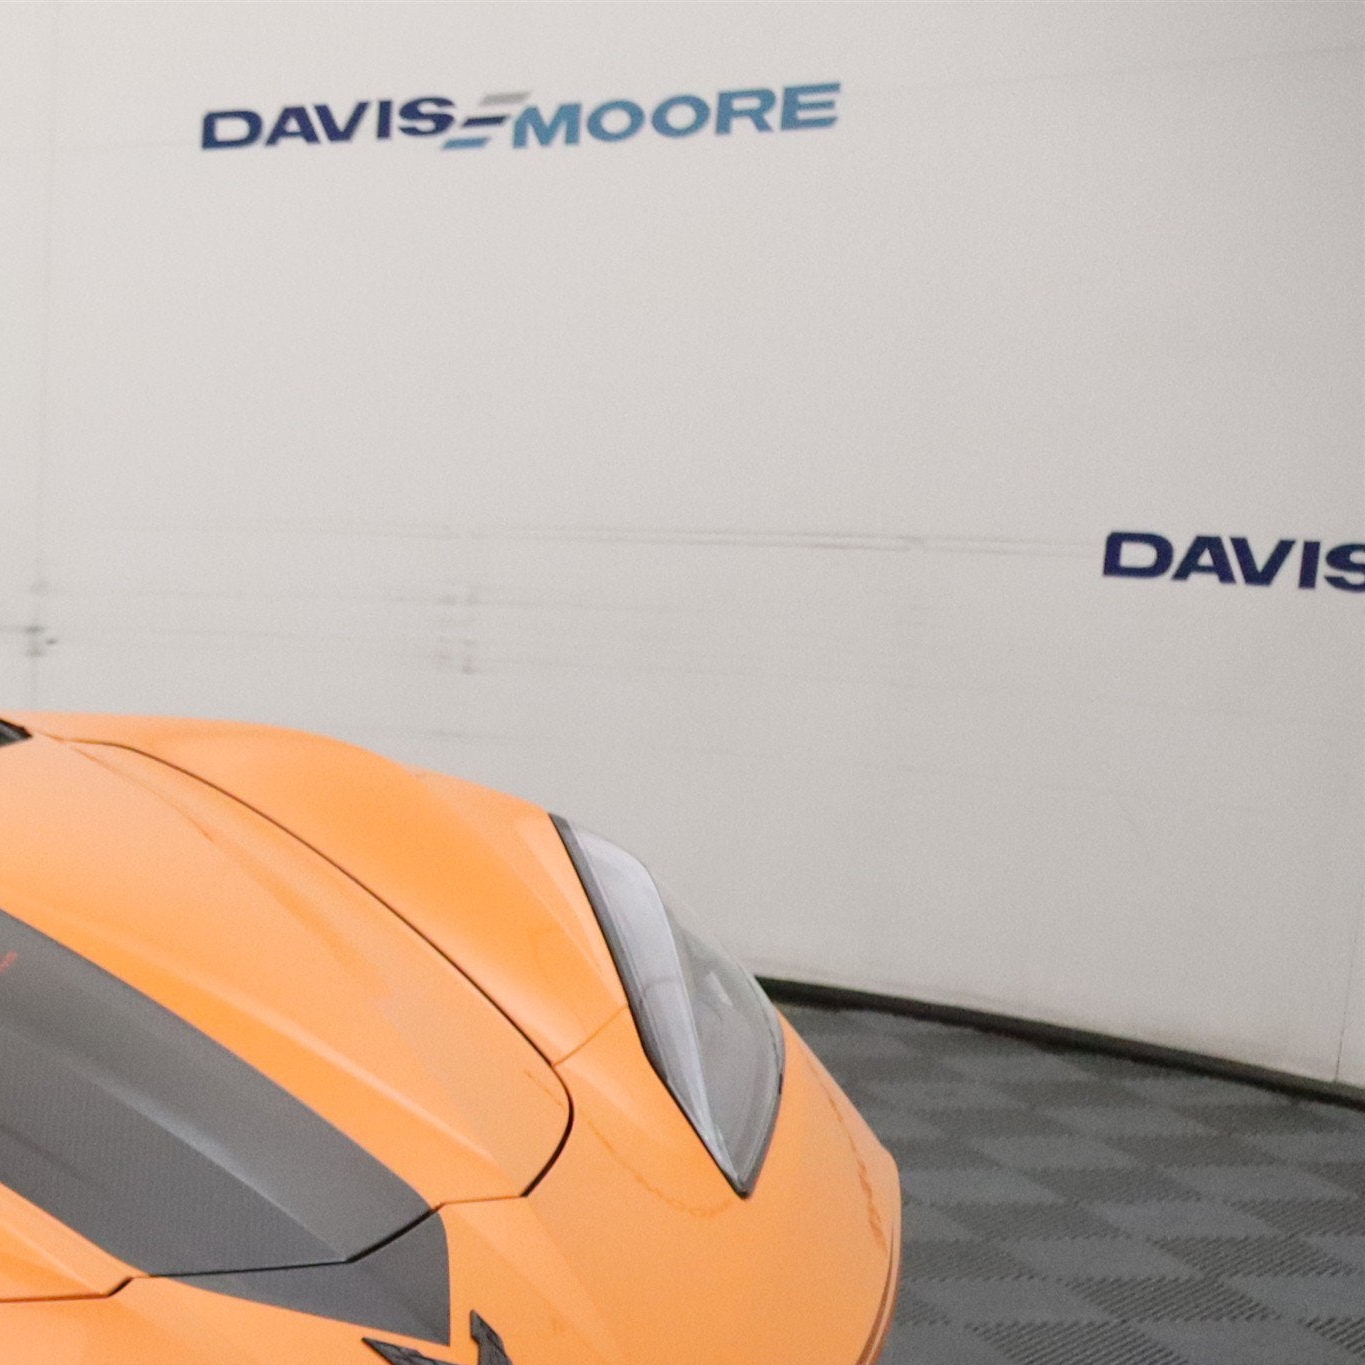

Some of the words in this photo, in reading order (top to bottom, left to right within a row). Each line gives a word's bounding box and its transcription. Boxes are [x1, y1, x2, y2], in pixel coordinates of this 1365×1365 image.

[201, 96, 456, 151] DAVIS
[511, 81, 843, 149] MOORE
[1101, 530, 1365, 593] DAVIS
